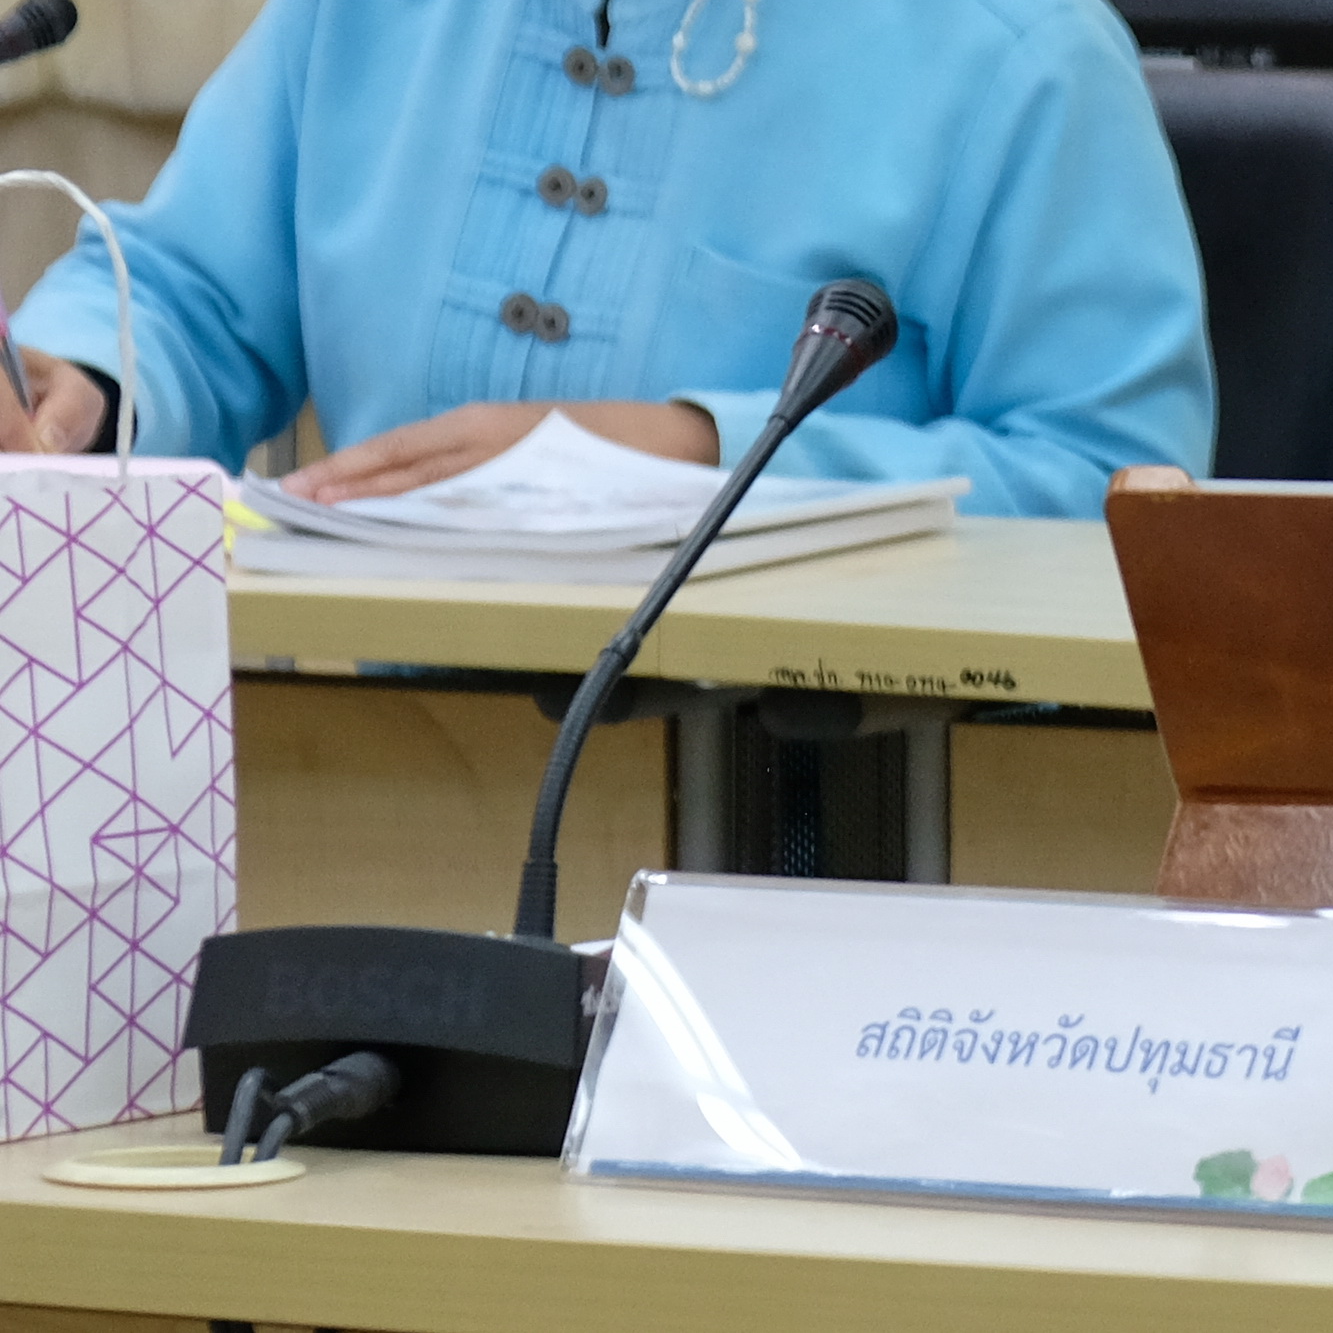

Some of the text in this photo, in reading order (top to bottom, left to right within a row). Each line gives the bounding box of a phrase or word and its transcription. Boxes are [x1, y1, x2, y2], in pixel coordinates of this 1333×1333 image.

[263, 960, 486, 1026] BOSCH
[855, 1006, 1301, 1095] สถิติจังหวัดปทุมธานี
